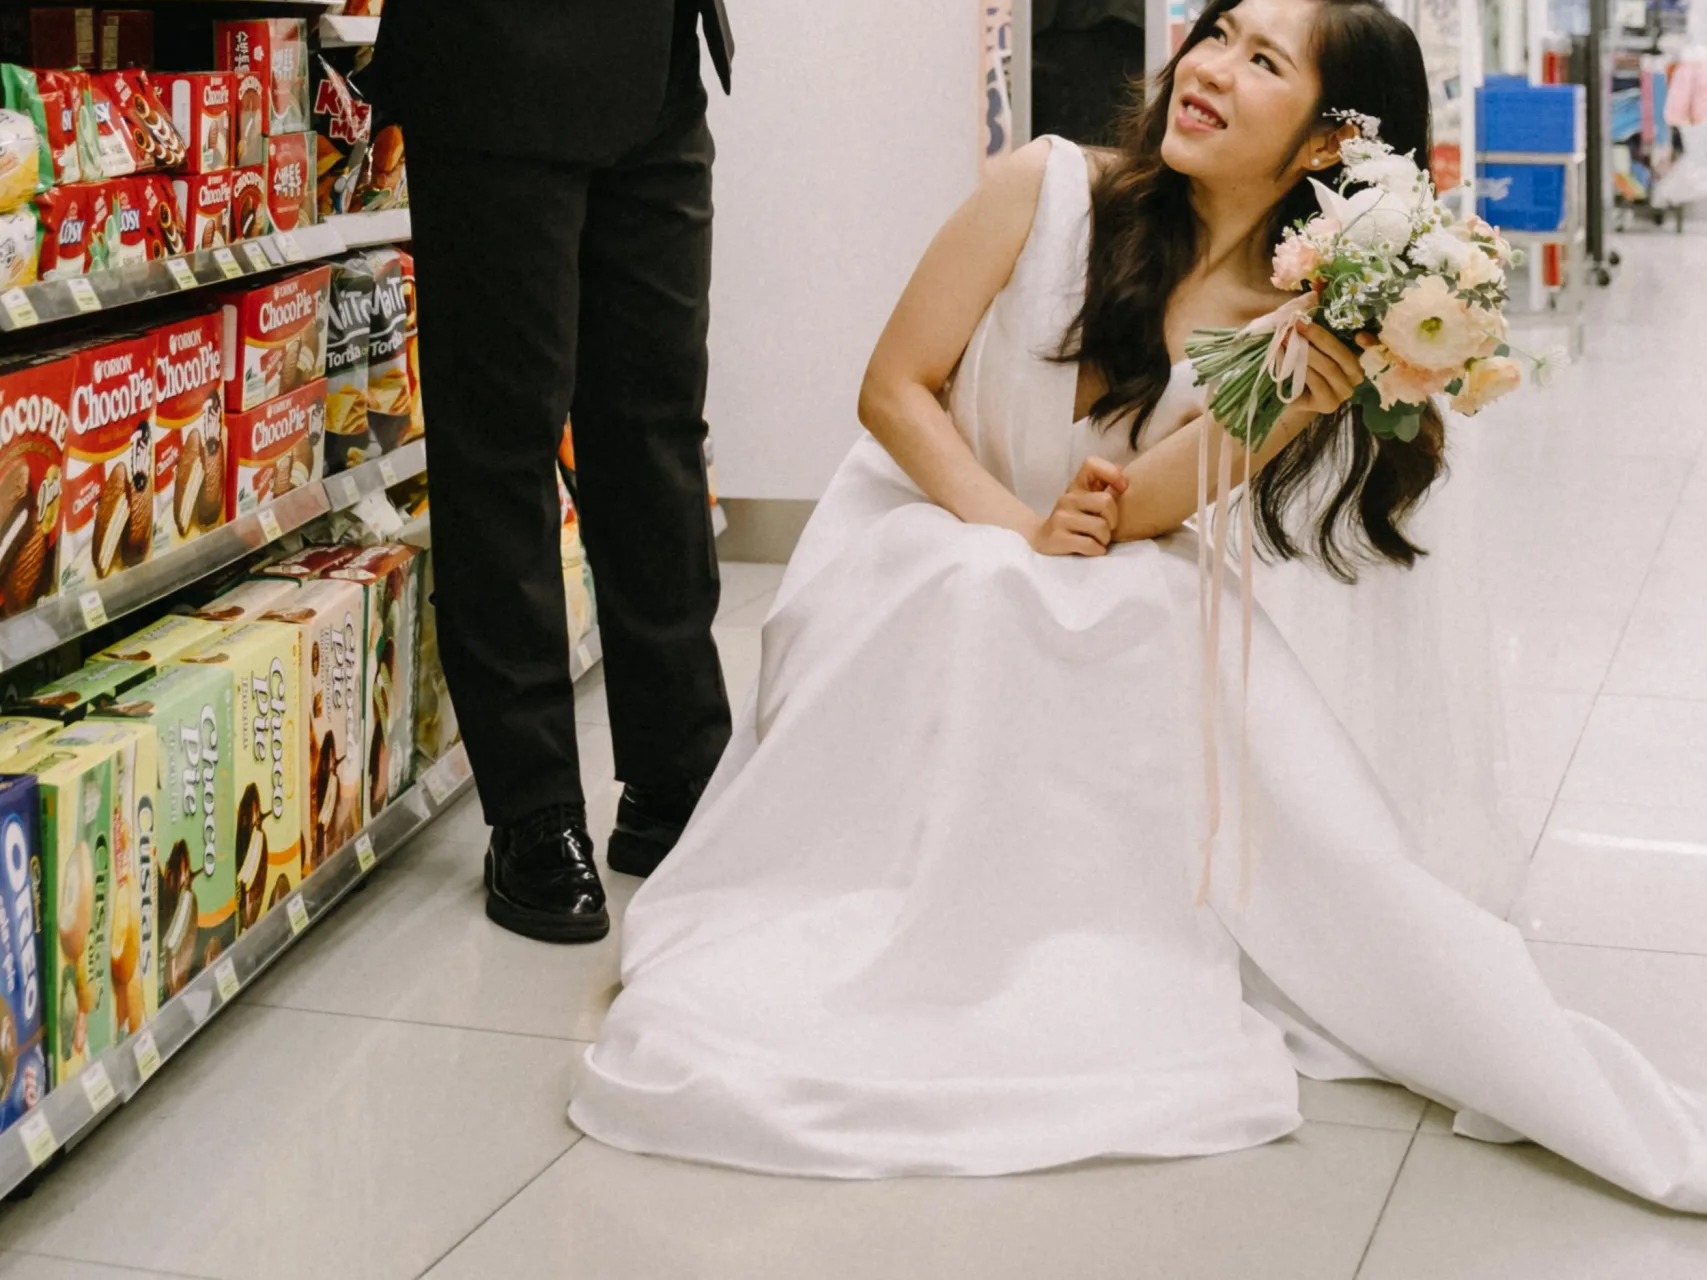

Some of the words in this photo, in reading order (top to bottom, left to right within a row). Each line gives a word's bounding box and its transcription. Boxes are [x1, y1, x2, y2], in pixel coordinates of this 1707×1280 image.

[59, 220, 86, 245] COSY
[100, 353, 133, 379] ORION
[177, 328, 202, 351] ORION
[0, 394, 69, 452] OCOPIE
[72, 367, 153, 436] ChocoPie
[330, 623, 346, 711] Pie
[251, 670, 271, 763] Pie
[268, 656, 287, 820] Choco
[178, 720, 203, 818] Pie
[199, 703, 220, 878] Choco
[4, 820, 37, 1021] OREO
[137, 795, 155, 976] Custas
